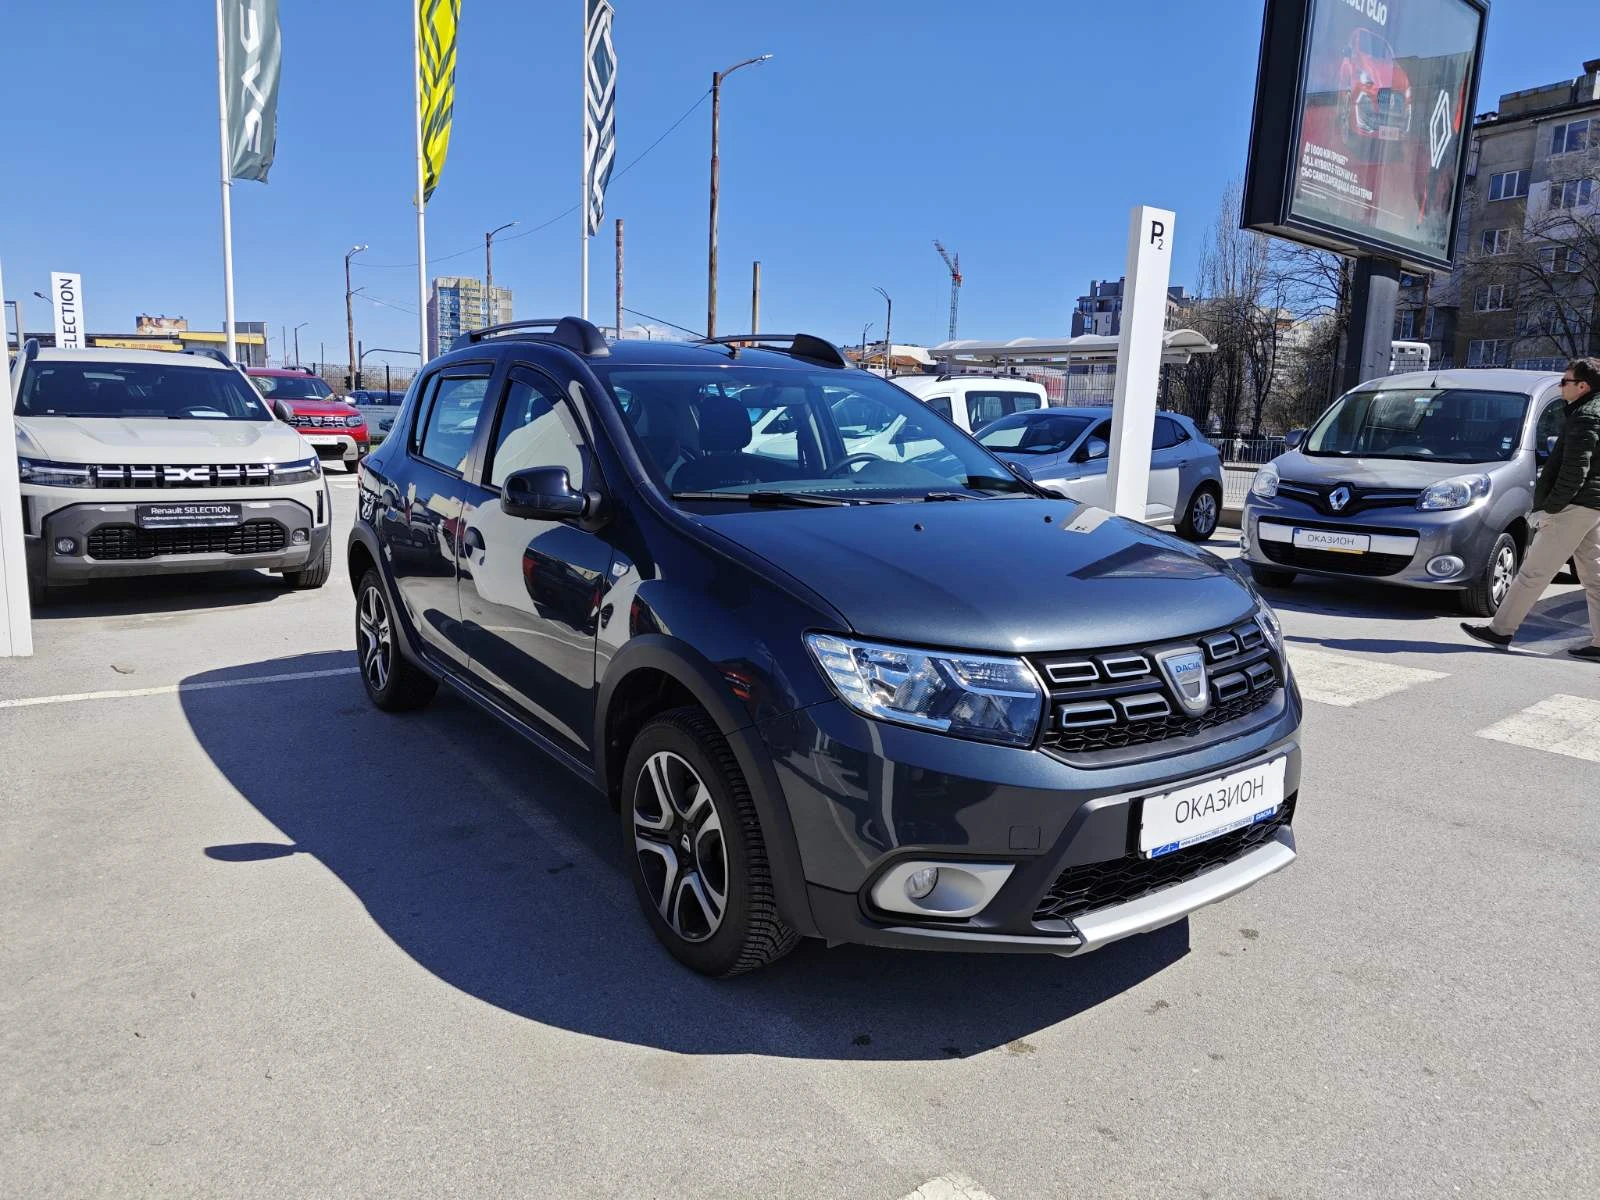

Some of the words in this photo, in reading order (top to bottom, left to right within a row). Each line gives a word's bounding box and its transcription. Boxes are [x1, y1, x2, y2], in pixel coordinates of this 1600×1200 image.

[1367, 0, 1387, 26] CLIO
[184, 506, 231, 514] SELECTION
[1307, 534, 1355, 546] ОКАЗИОН
[1175, 661, 1201, 673] DACIA
[1175, 775, 1264, 823] ОКАЗИОН
